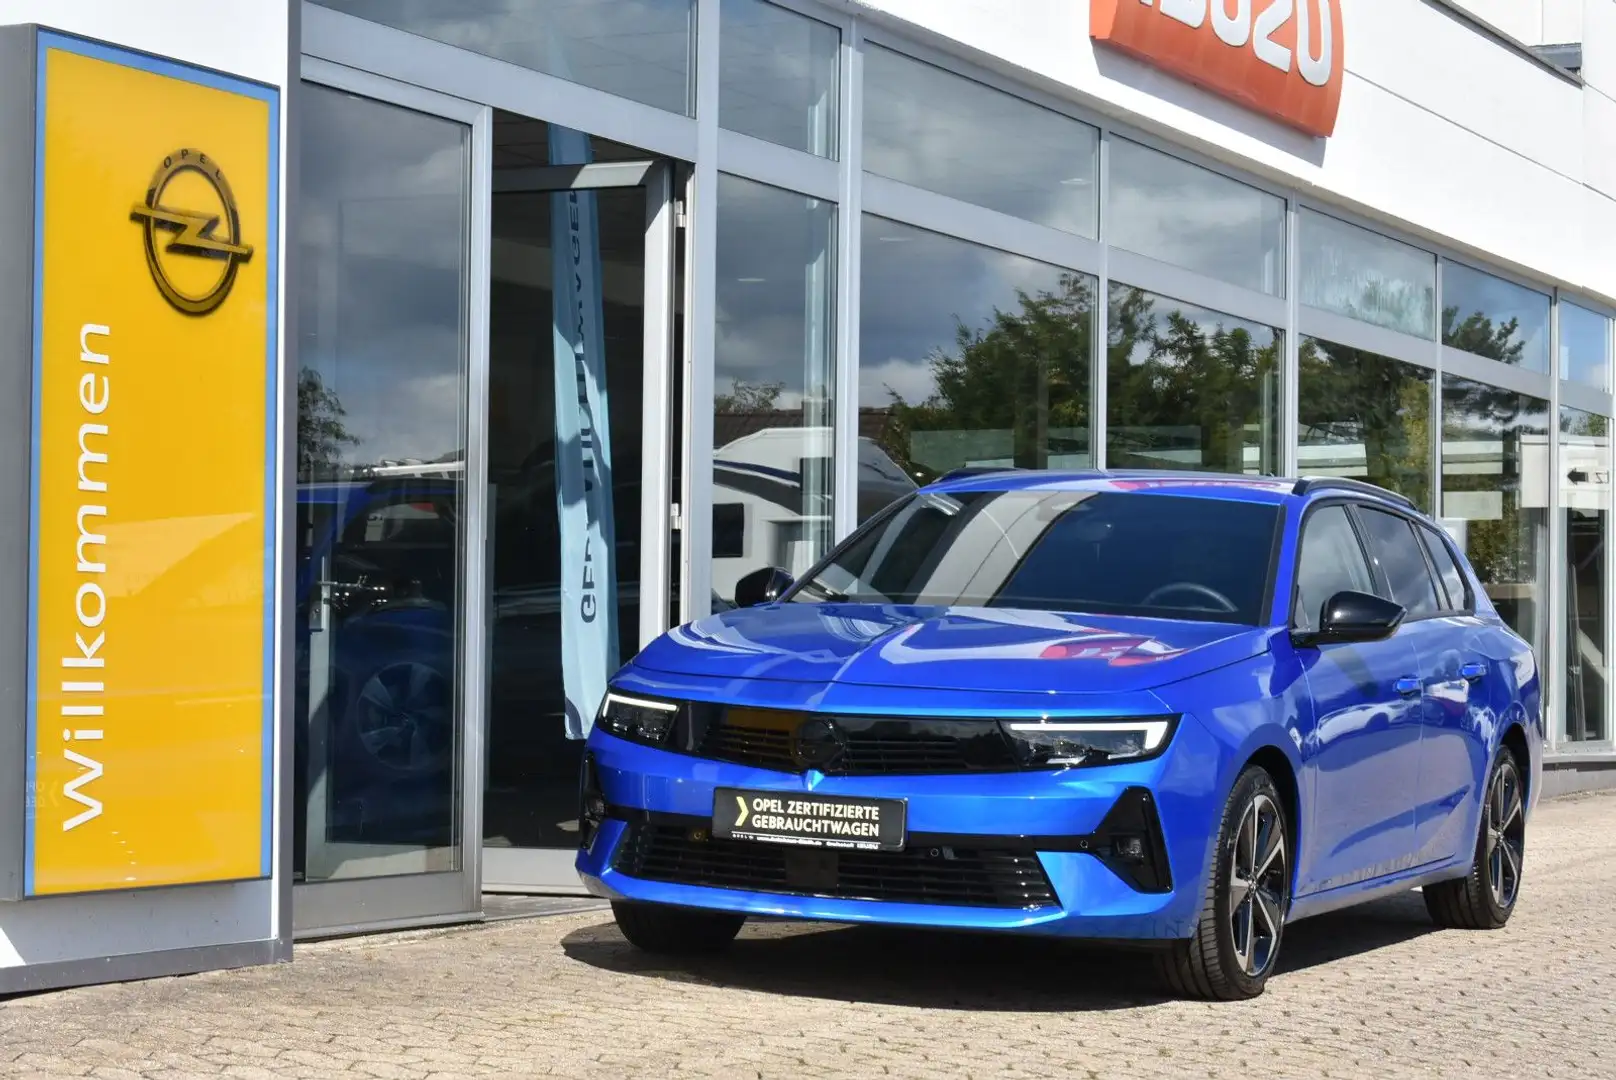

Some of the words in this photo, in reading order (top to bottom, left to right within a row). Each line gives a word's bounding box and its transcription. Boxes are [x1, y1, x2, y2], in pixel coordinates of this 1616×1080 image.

[163, 148, 222, 181] OPEL
[61, 322, 111, 832] Willkommen
[752, 798, 784, 814] OPEL
[787, 800, 880, 820] ZERTIFIZIERTE
[751, 814, 880, 837] GEBRAUCHTWAGEN
